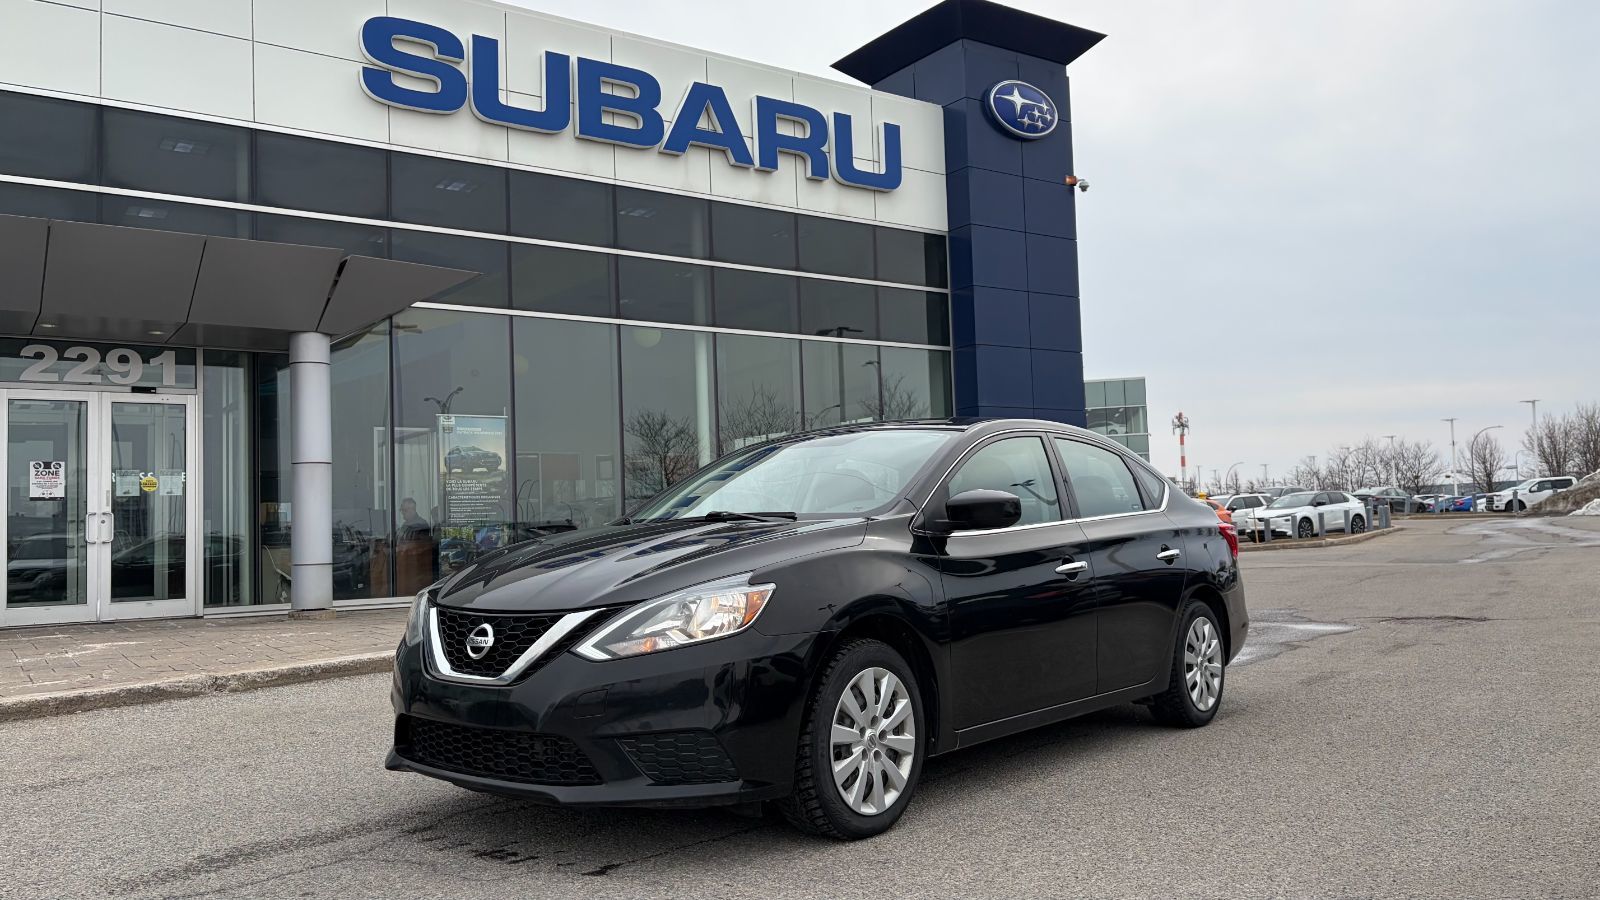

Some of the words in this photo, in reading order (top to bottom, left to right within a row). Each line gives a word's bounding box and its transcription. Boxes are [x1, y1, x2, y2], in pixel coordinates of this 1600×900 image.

[359, 16, 902, 192] SUBARU
[19, 344, 176, 386] 2291
[468, 637, 489, 645] NISSAN
